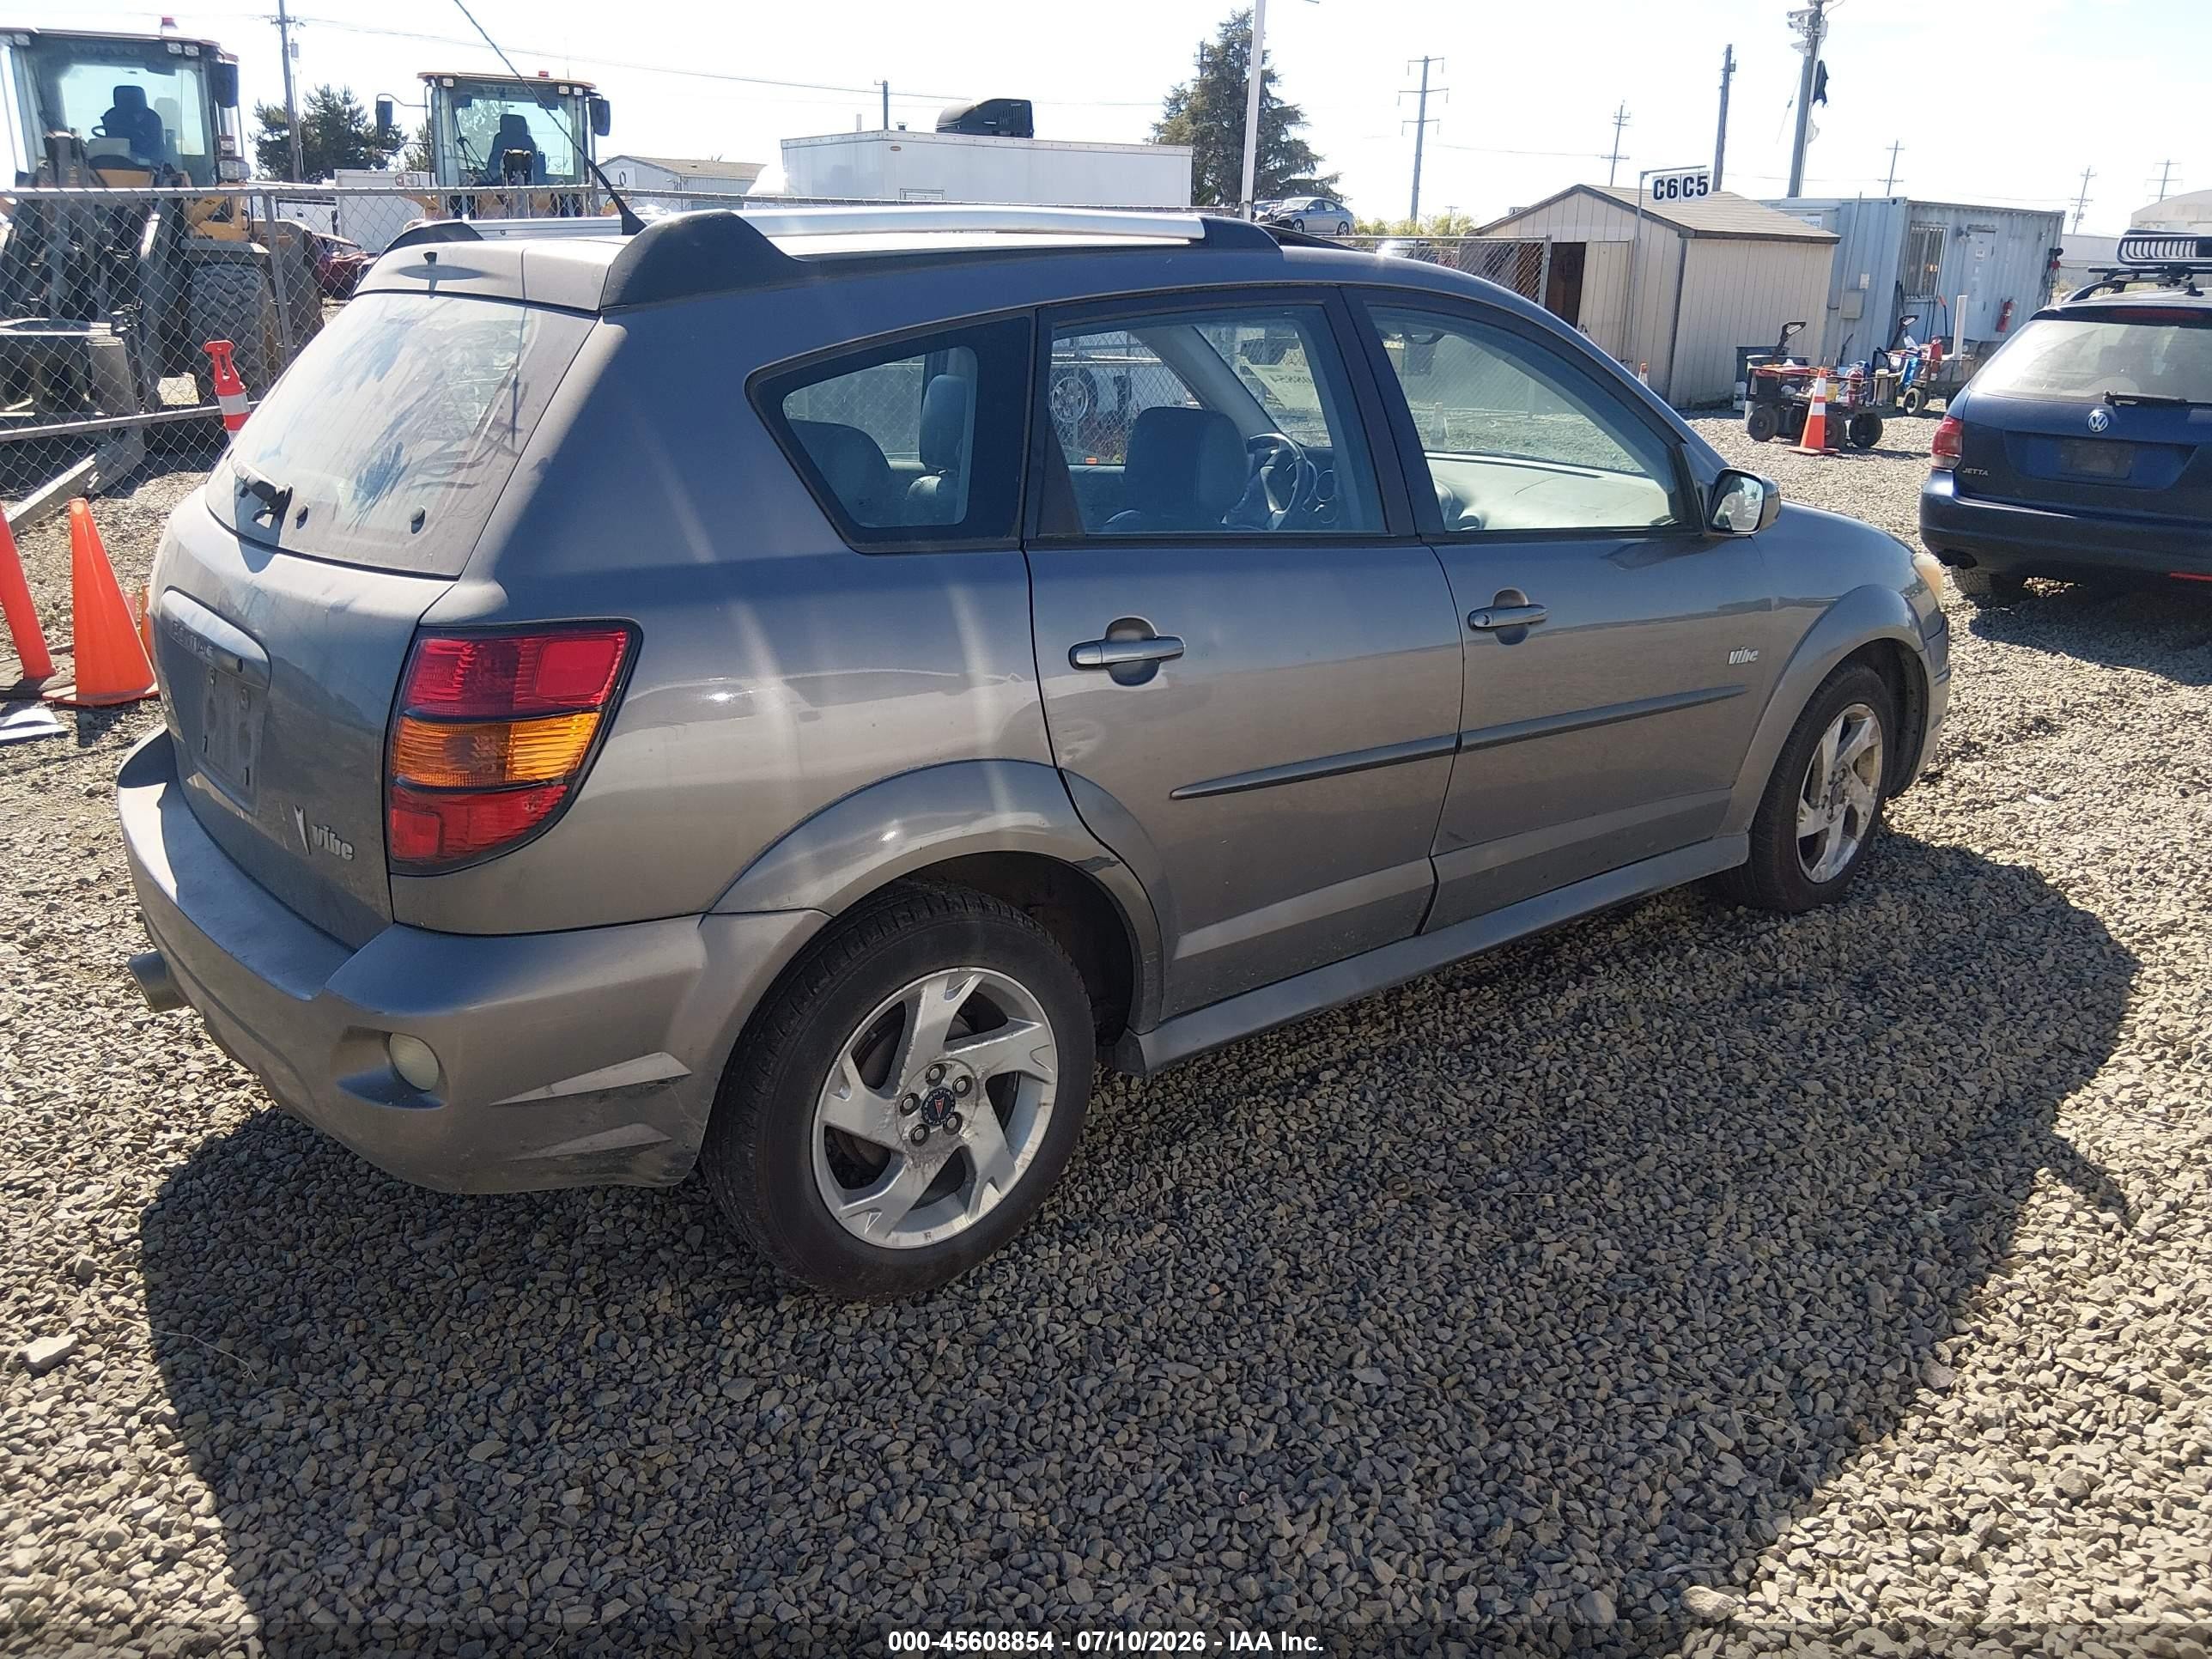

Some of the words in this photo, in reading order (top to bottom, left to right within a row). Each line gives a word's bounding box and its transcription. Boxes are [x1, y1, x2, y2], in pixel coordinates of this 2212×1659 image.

[1653, 178, 1679, 200] C6
[1682, 175, 1709, 198] C5
[1962, 467, 1989, 477] JETTA
[310, 823, 355, 860] vibe
